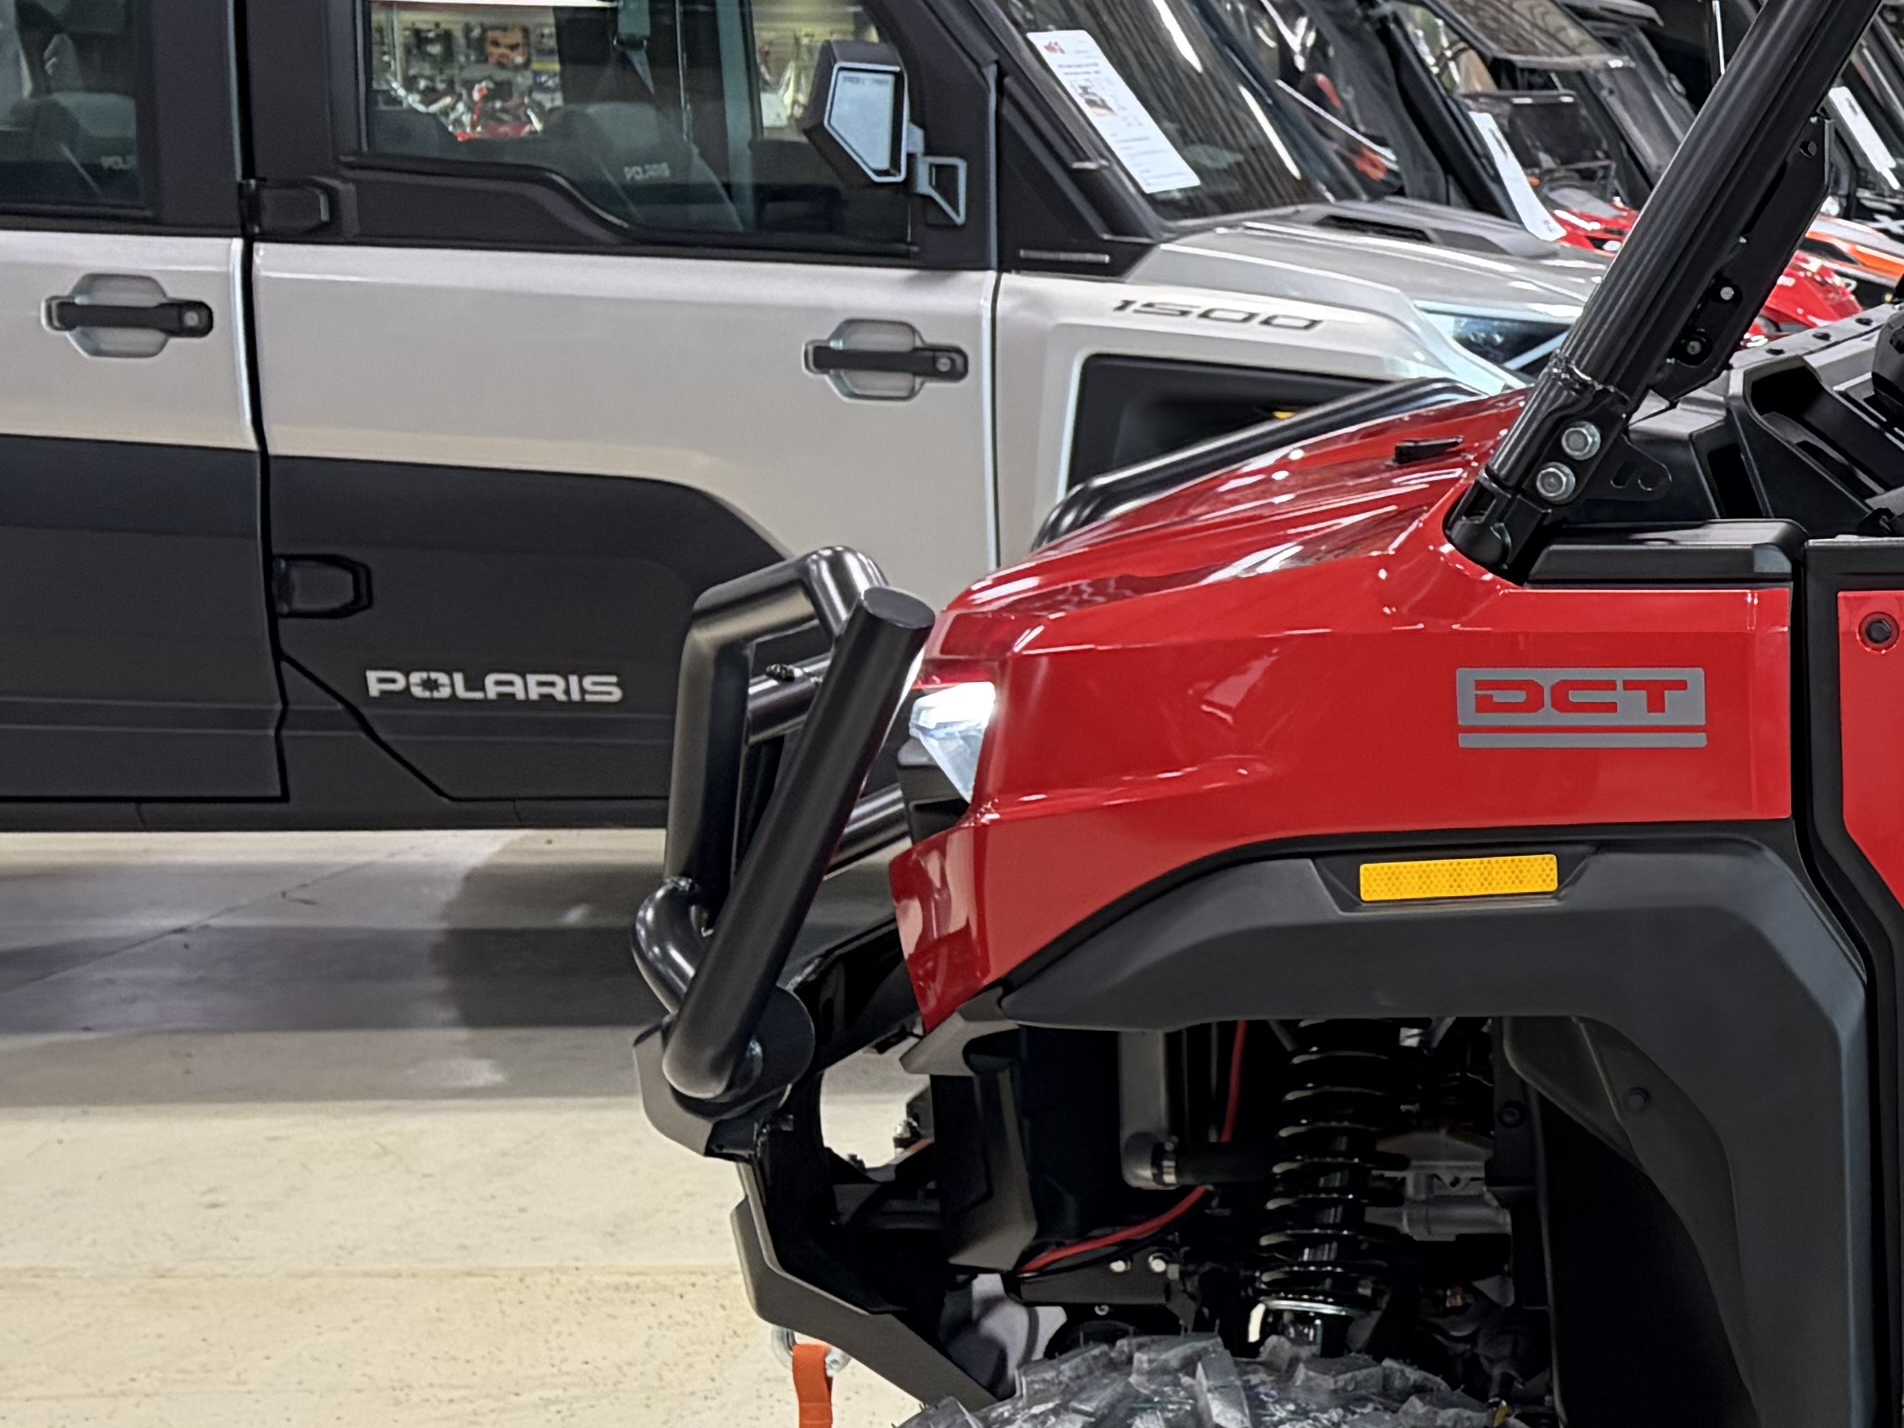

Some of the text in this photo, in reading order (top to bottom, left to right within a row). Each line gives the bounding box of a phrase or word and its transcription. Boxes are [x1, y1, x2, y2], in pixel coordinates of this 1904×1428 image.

[1112, 298, 1322, 332] 1500
[366, 670, 622, 703] POLARIS
[1474, 679, 1688, 714] DCT
